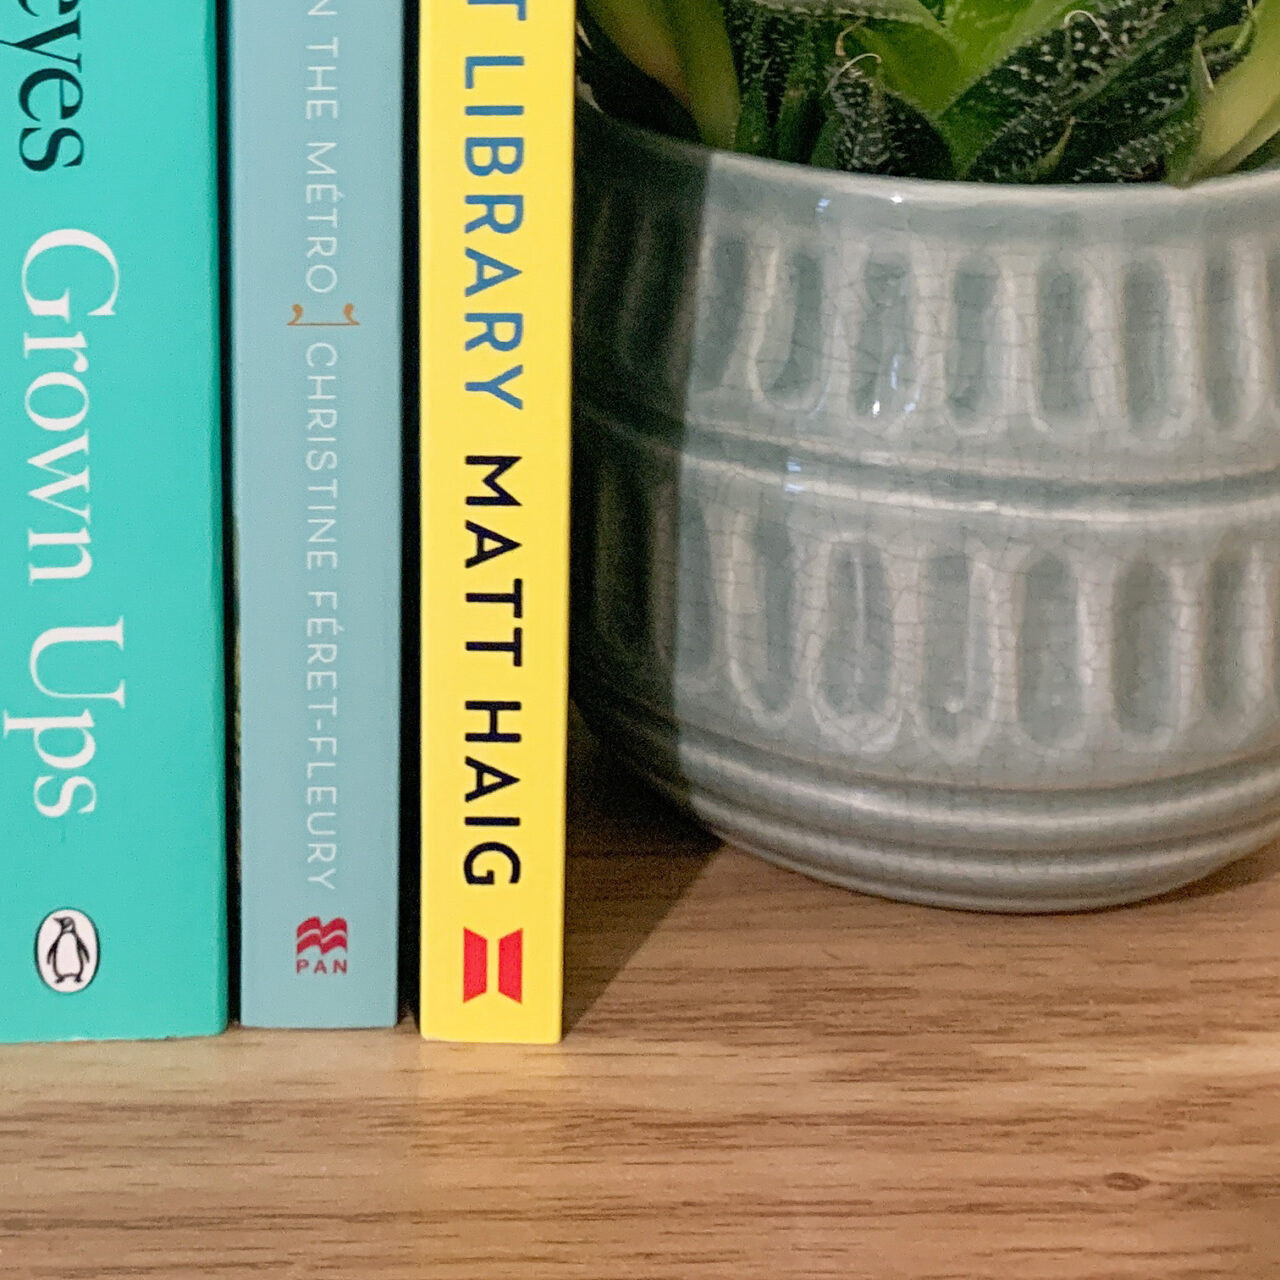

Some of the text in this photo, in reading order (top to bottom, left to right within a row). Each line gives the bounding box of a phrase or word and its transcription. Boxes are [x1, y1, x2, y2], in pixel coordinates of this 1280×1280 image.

[305, 142, 343, 293] MÉTRO
[306, 37, 338, 120] THE
[463, 55, 525, 411] LIBRARY
[3, 228, 126, 819] Grown Ups
[306, 342, 343, 890] CHRISTINE FÉRET-FLEURY
[463, 455, 524, 886] MATT HAIG
[296, 959, 348, 974] PAN
